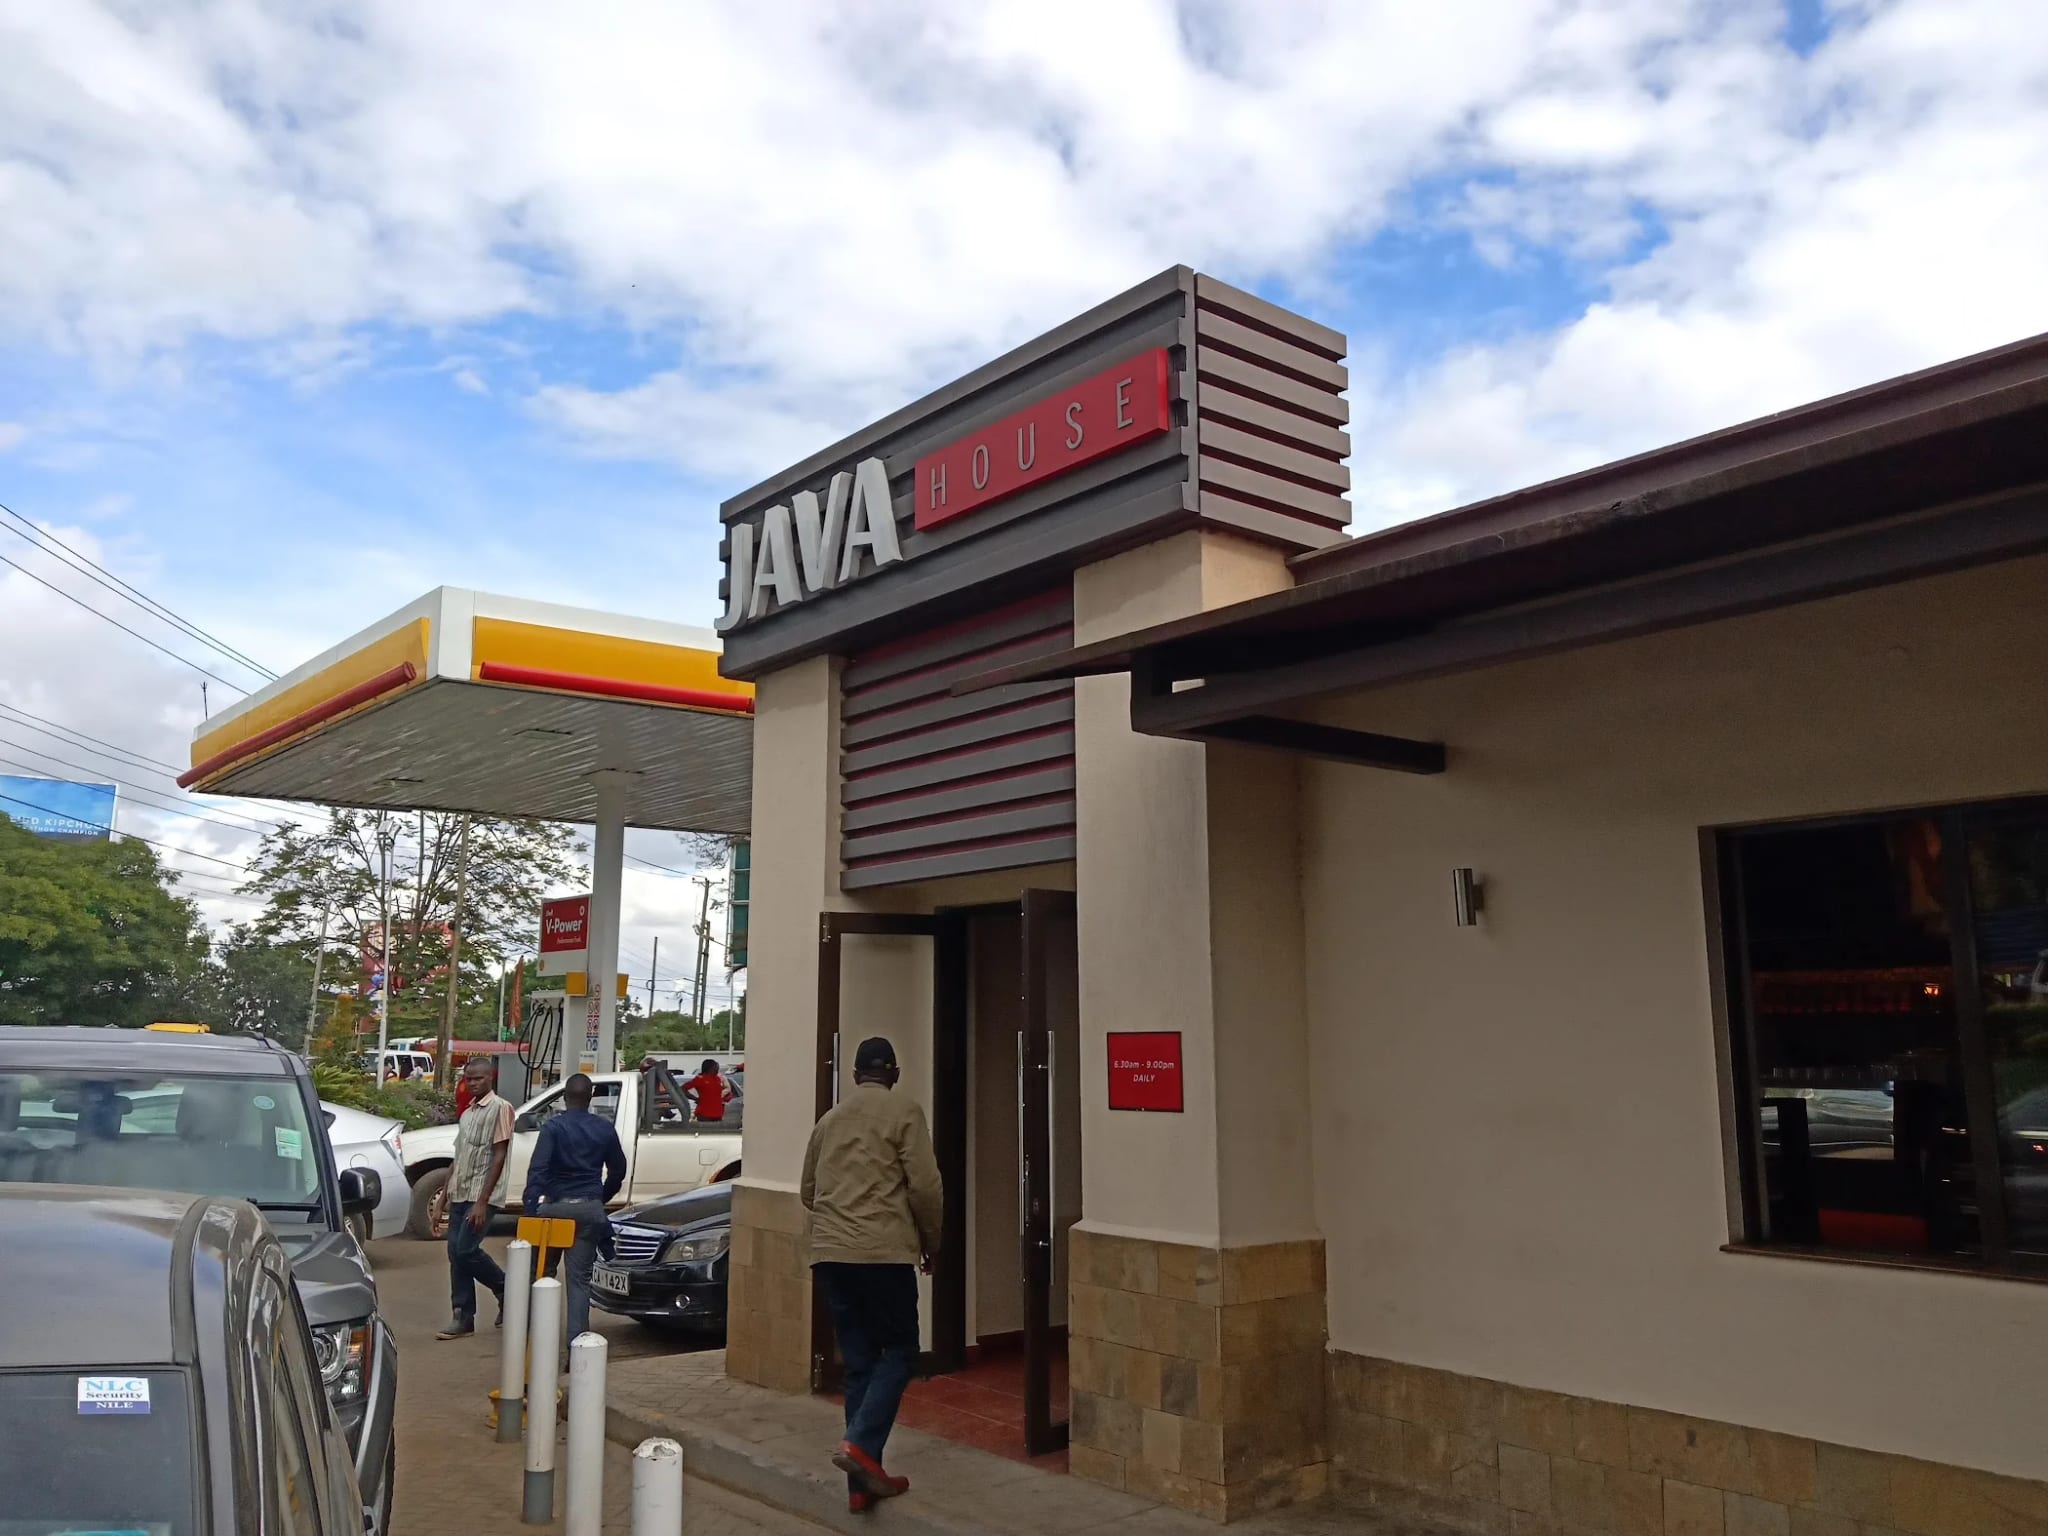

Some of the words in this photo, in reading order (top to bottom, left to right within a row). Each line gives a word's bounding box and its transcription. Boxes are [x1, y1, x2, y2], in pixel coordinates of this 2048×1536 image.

[714, 456, 903, 632] JAVA
[930, 376, 1135, 510] HOUSE
[57, 828, 99, 836] CHAMPION
[545, 917, 583, 935] V-Power
[1146, 1060, 1175, 1071] 9.00pm
[1133, 1074, 1156, 1082] DAILY
[605, 1272, 627, 1292] 142X
[85, 1380, 142, 1392] NLC
[86, 1392, 143, 1400] Security
[96, 1401, 134, 1409] NILE
